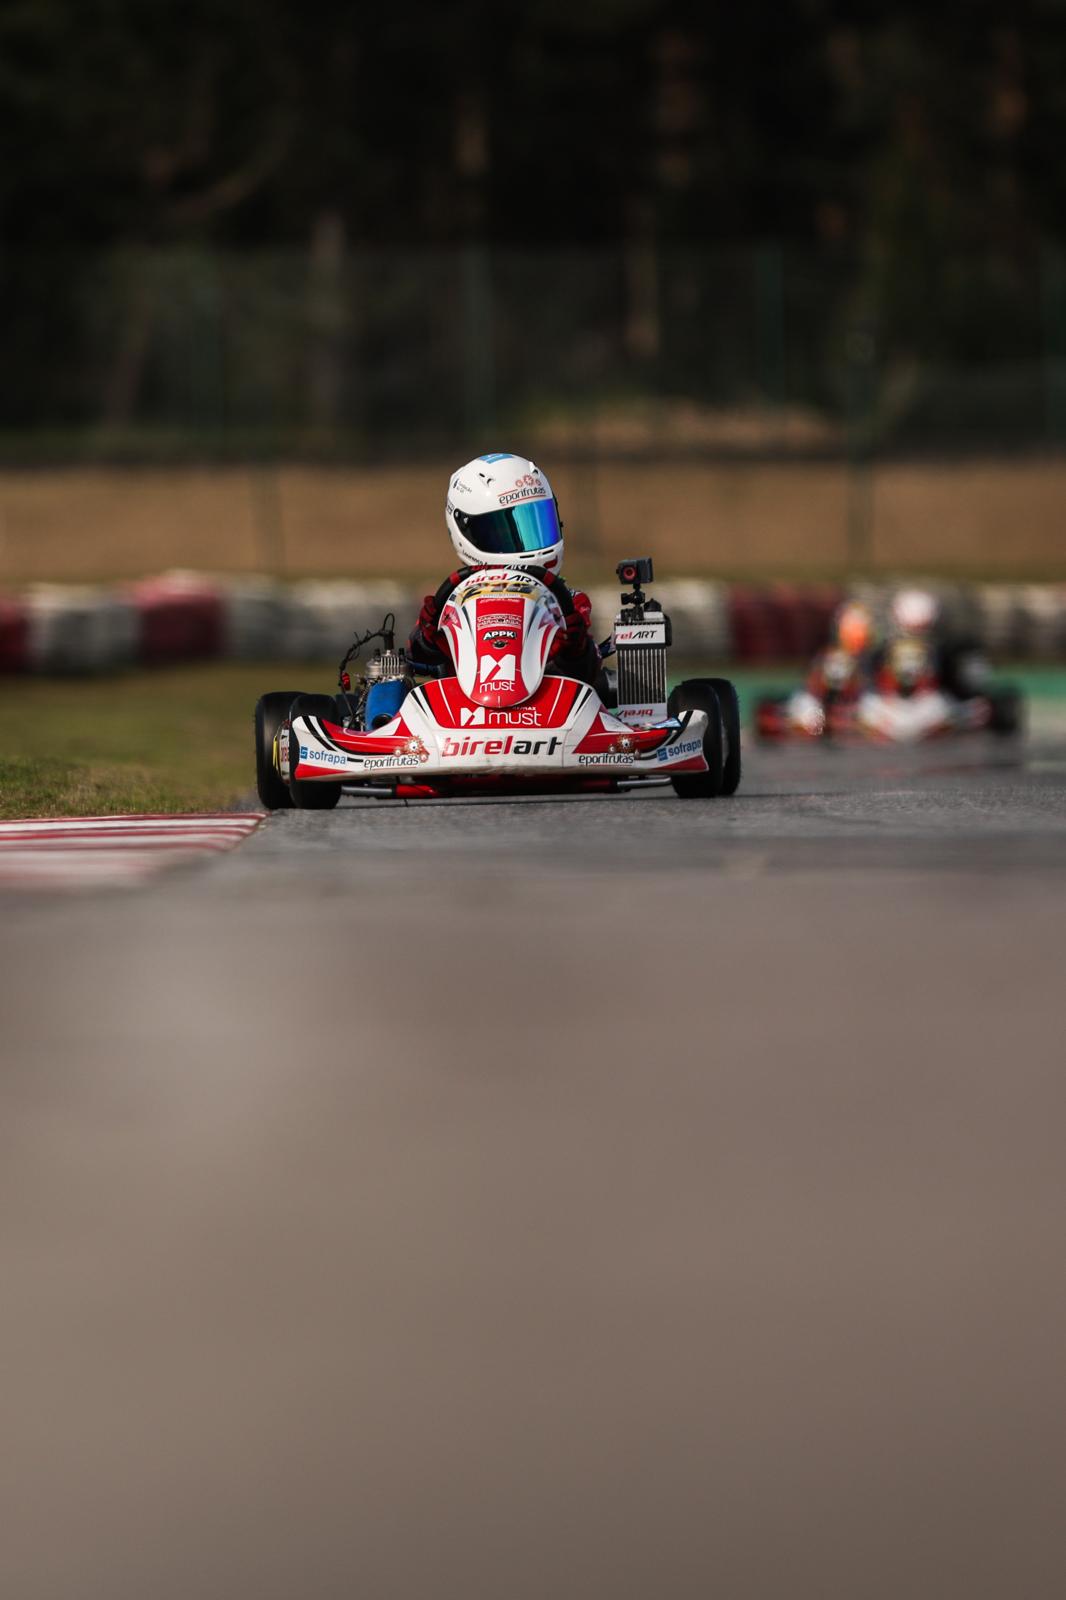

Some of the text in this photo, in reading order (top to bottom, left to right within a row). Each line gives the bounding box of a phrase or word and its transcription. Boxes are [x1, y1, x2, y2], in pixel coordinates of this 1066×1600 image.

[498, 486, 546, 505] eporifrutas
[483, 631, 515, 641] APPK
[613, 630, 657, 640] relART
[480, 681, 515, 693] must
[488, 711, 542, 726] must
[442, 735, 562, 757] birelart
[668, 739, 702, 758] sofrapa
[309, 749, 346, 765] sofrapa
[363, 756, 419, 770] eporifrutas
[578, 753, 634, 766] eporifrutas
